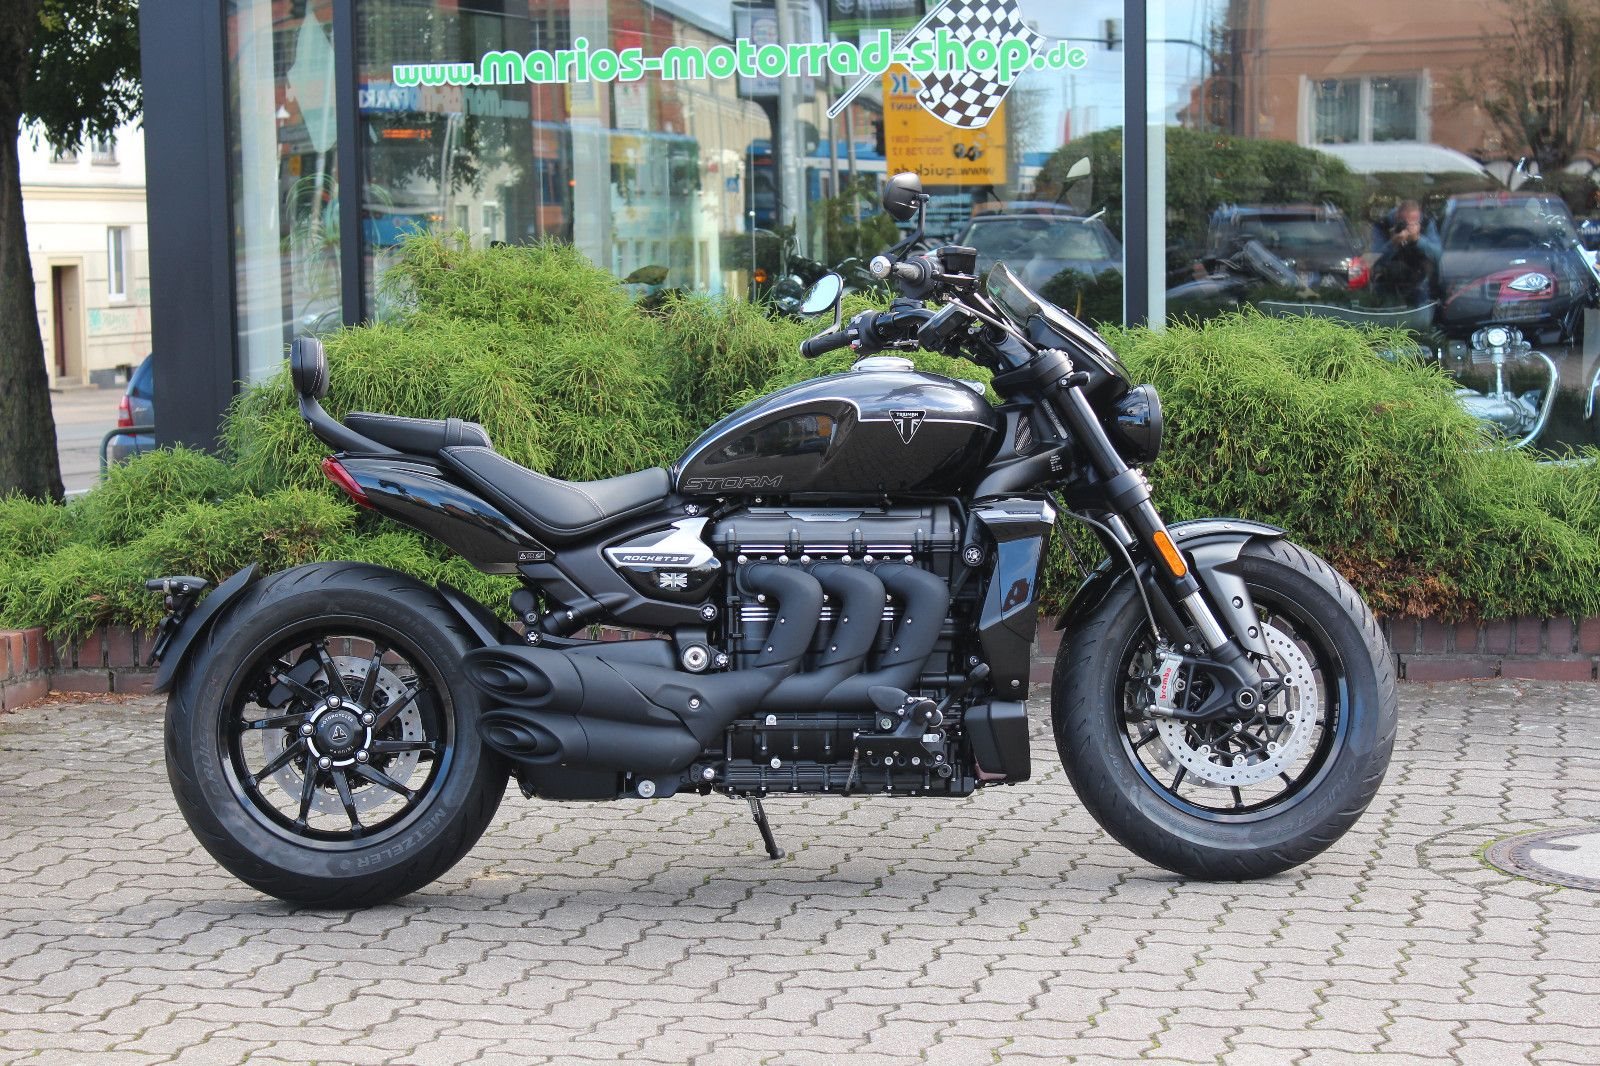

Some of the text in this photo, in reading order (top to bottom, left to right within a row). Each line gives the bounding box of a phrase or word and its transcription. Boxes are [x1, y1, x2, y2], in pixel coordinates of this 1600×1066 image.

[392, 28, 1088, 87] www.marios-motorrad-shop.de
[684, 474, 783, 489] STORM
[1160, 667, 1172, 699] brembo
[356, 807, 448, 868] METZELER
